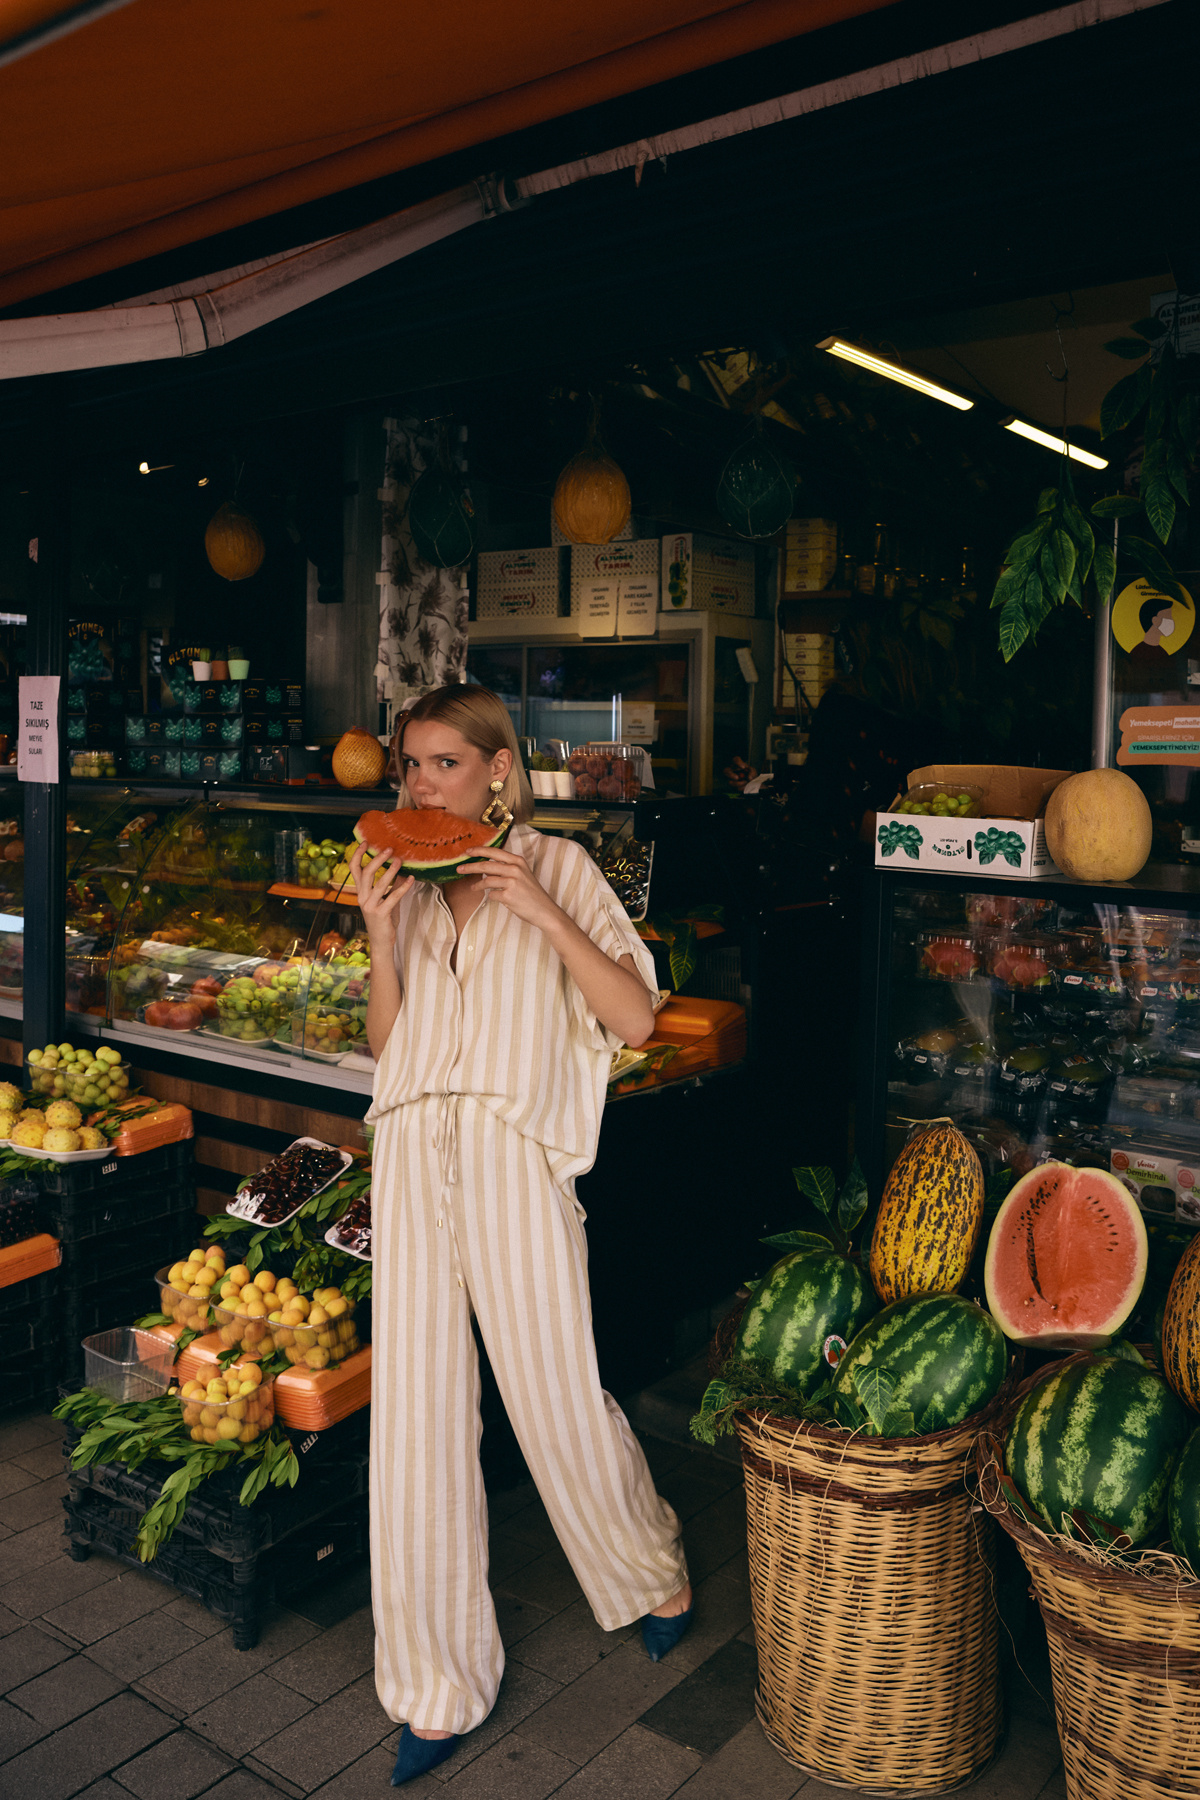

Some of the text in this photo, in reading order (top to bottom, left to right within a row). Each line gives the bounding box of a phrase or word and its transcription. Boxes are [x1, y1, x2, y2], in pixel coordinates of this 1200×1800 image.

[168, 647, 200, 665] ALTUN
[30, 701, 43, 710] TAZE
[25, 719, 50, 730] SIKILMIŞ
[1129, 719, 1173, 728] Yemeksepeti
[1126, 1168, 1166, 1181] Demirhindi
